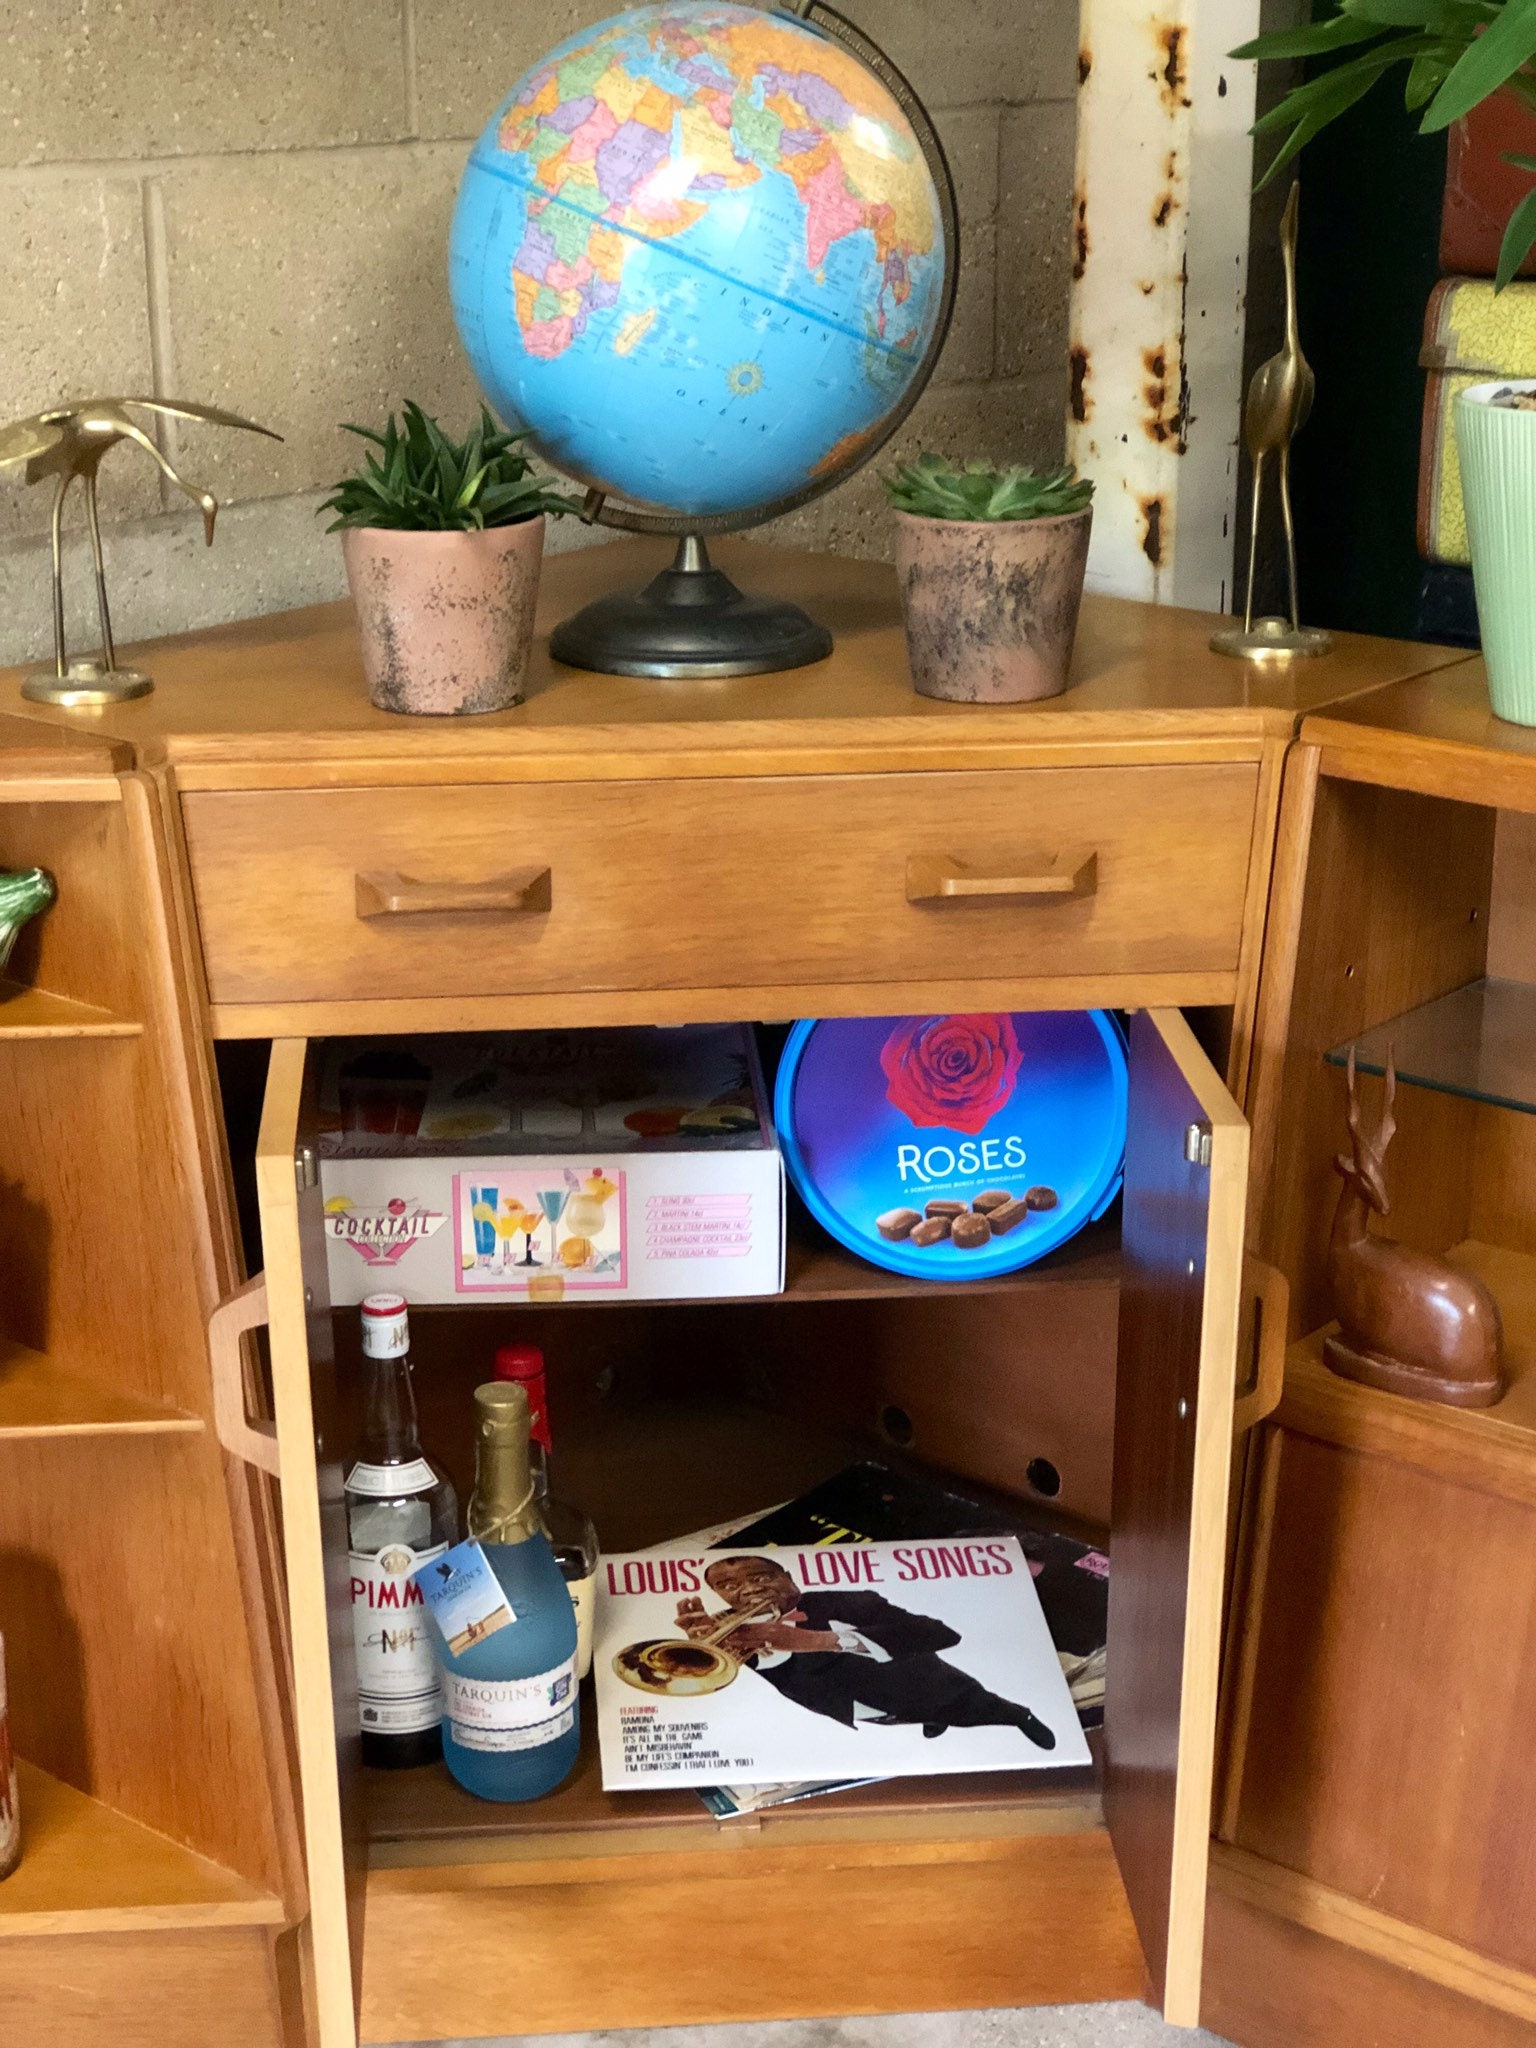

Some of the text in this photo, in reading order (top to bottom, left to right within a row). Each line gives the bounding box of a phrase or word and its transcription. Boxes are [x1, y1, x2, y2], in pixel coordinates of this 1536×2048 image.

[720, 286, 830, 344] INDIAN
[675, 387, 769, 432] OCEAN
[896, 1135, 1027, 1183] ROSES
[333, 1216, 430, 1236] COCKTAIL
[606, 1543, 1014, 1596] LOUIS' LOVE SONGS
[452, 1682, 542, 1706] TARQUIN'S
[653, 1724, 665, 1732] MY
[667, 1722, 709, 1732] SOUVENIRS
[654, 1734, 662, 1742] IN
[666, 1733, 677, 1742] THE
[682, 1732, 703, 1741] GAME
[636, 1754, 648, 1762] MY
[675, 1750, 720, 1760] COMPANION
[714, 1759, 730, 1768] LOVE
